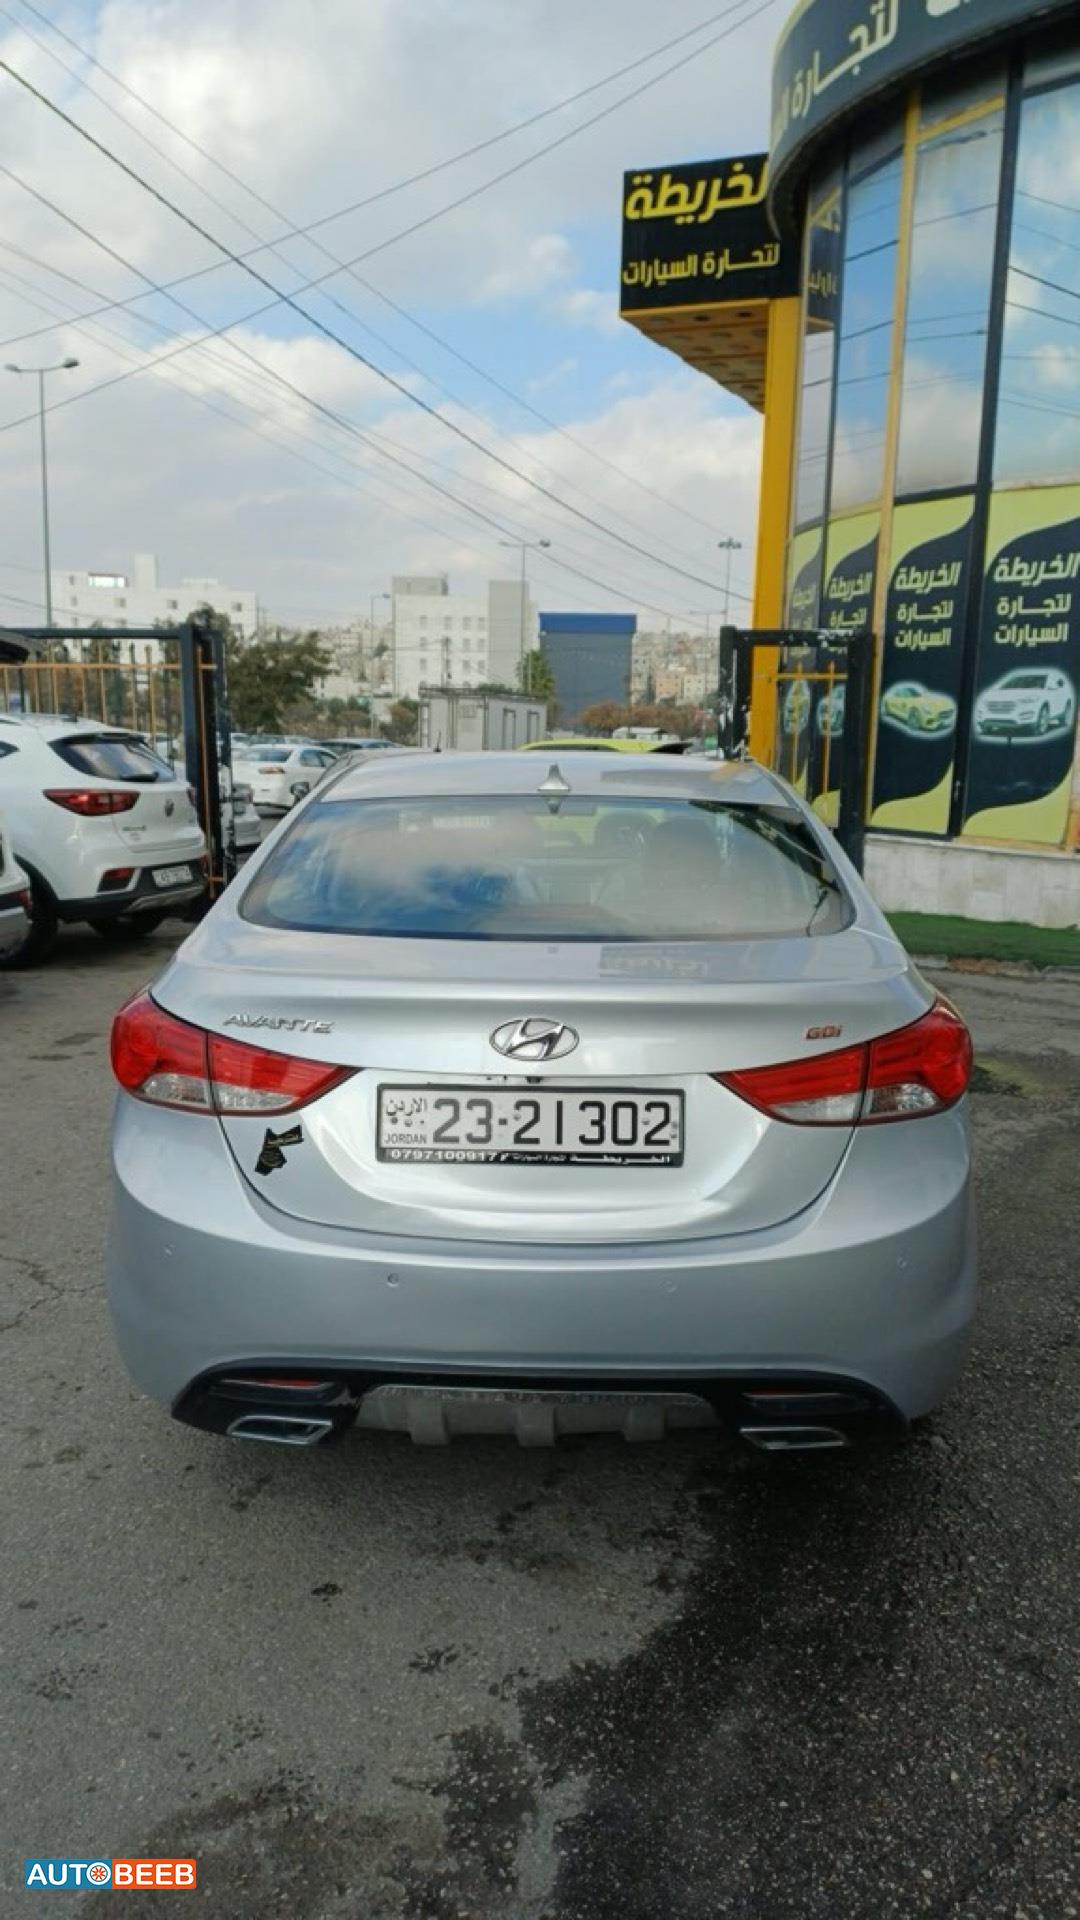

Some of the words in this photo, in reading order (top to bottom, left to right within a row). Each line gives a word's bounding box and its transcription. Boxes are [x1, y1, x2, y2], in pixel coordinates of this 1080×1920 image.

[625, 161, 769, 226] لخريطة
[622, 253, 698, 288] السيارات
[894, 561, 962, 594] الخريطة
[993, 552, 1080, 587] الخريطة
[896, 599, 954, 624] لتجارة
[996, 593, 1072, 619] لتجارة
[894, 627, 952, 651] السيارات
[994, 622, 1069, 648] السيارات
[222, 1015, 334, 1034] AVANTE
[432, 1098, 671, 1147] 23-21302
[384, 1133, 428, 1145] JORDAN
